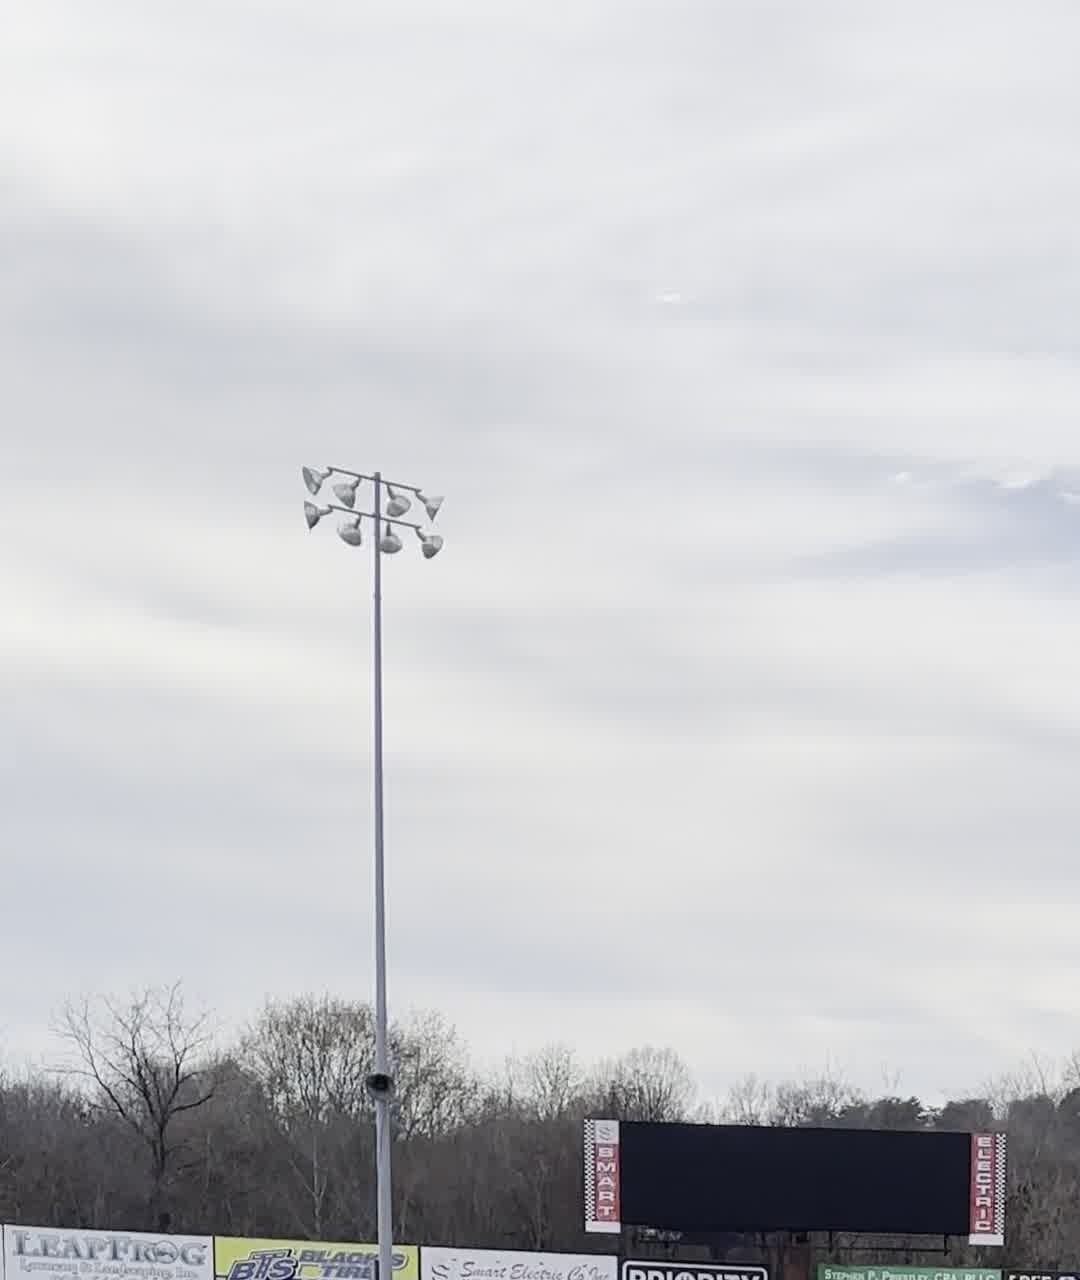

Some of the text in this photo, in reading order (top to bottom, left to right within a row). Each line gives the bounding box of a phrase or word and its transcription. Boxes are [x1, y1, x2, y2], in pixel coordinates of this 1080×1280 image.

[597, 1146, 616, 1216] SMART
[975, 1136, 992, 1230] ELECTRIC
[460, 1262, 507, 1278] Smart
[510, 1264, 563, 1280] Electric
